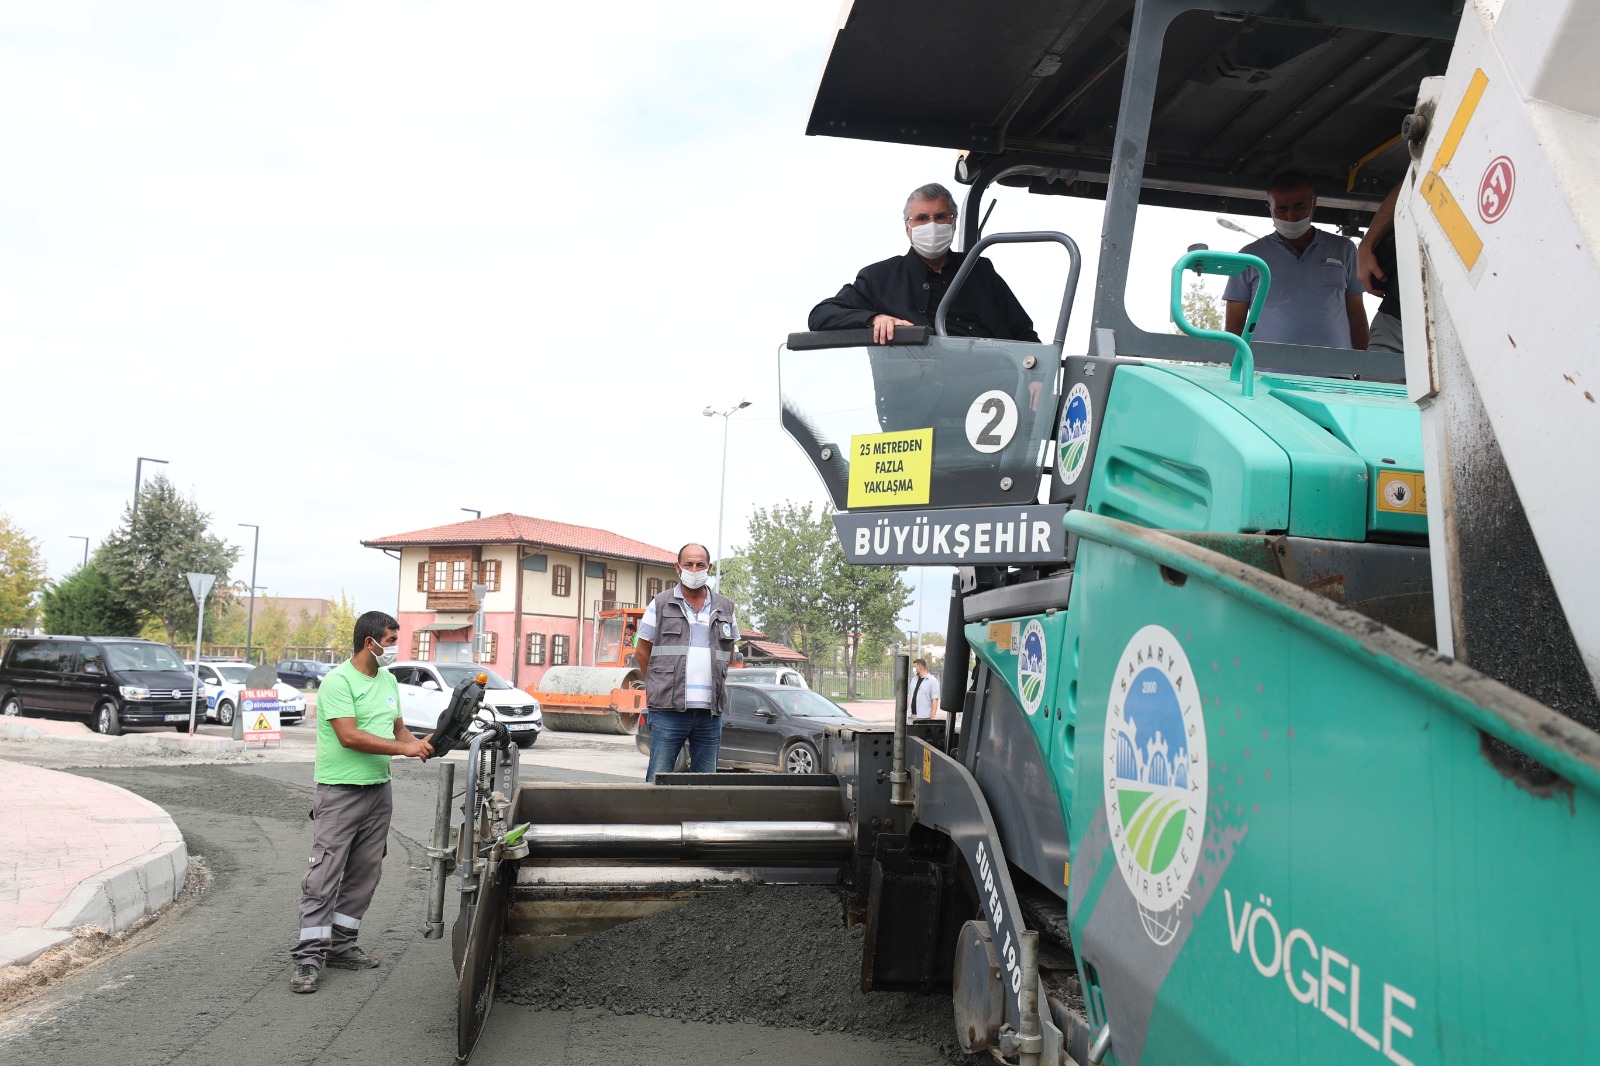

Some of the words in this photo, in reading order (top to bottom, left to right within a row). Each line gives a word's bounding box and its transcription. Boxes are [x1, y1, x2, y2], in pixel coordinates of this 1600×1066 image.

[1482, 163, 1507, 215] 37
[975, 397, 1006, 446] 2
[860, 443, 871, 456] 25
[873, 439, 922, 455] METREDEN
[875, 460, 904, 474] FAZLA
[864, 479, 913, 496] YAKLAŞMA
[854, 512, 1051, 559] BÜYÜKŞEHİR
[1120, 644, 1183, 693] SAKARYA
[1142, 681, 1157, 693] 2000
[975, 840, 1004, 935] SUPER
[1002, 930, 1022, 1013] 190
[1224, 888, 1417, 1066] VÖGELE
